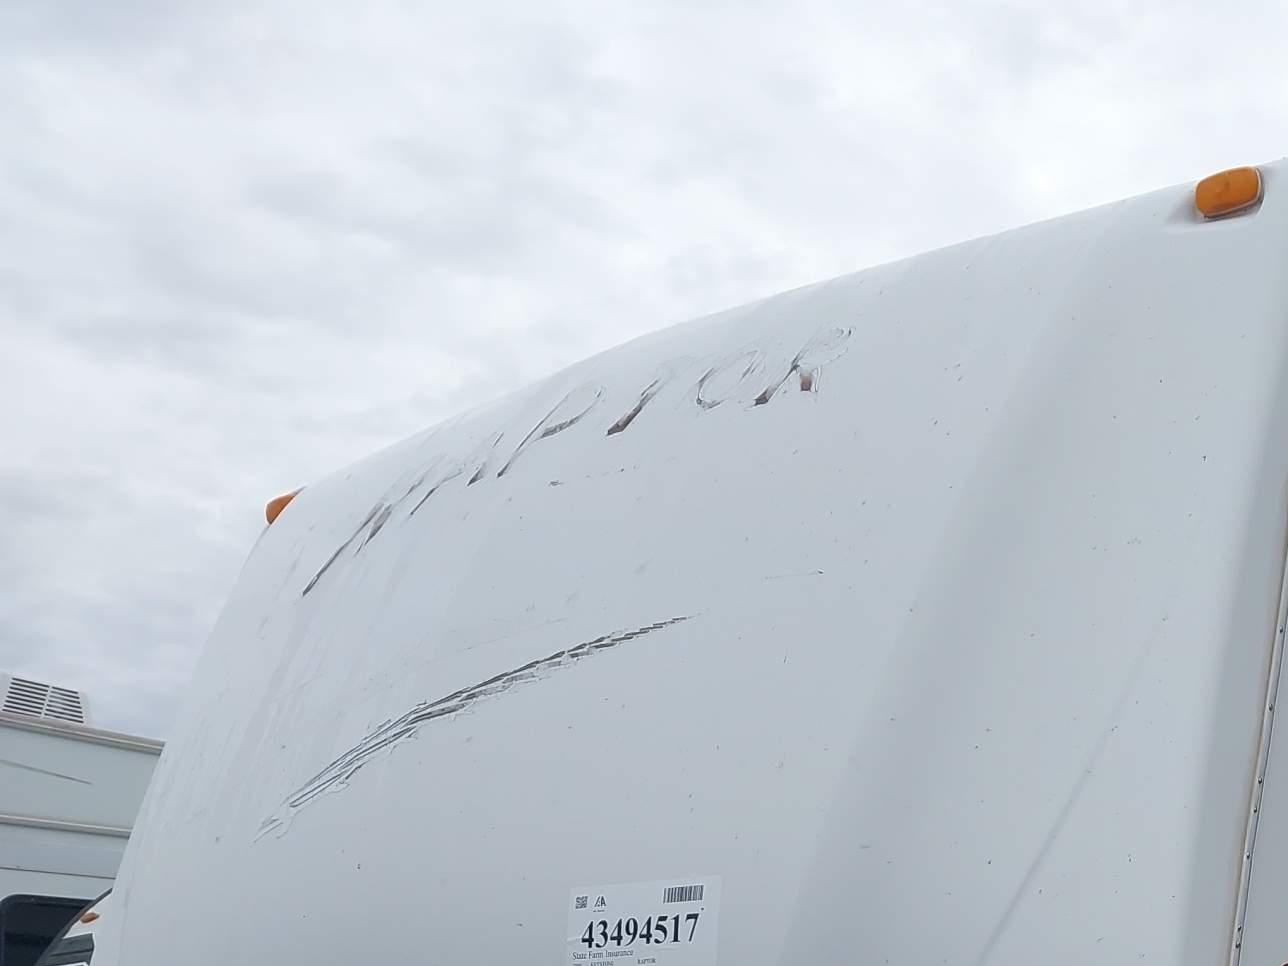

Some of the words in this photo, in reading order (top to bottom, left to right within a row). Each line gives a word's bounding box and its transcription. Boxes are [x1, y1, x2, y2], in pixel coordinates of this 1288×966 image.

[581, 912, 700, 949] 43494517
[572, 951, 587, 961] State
[588, 950, 604, 960] Farm
[605, 949, 634, 959] Insurance
